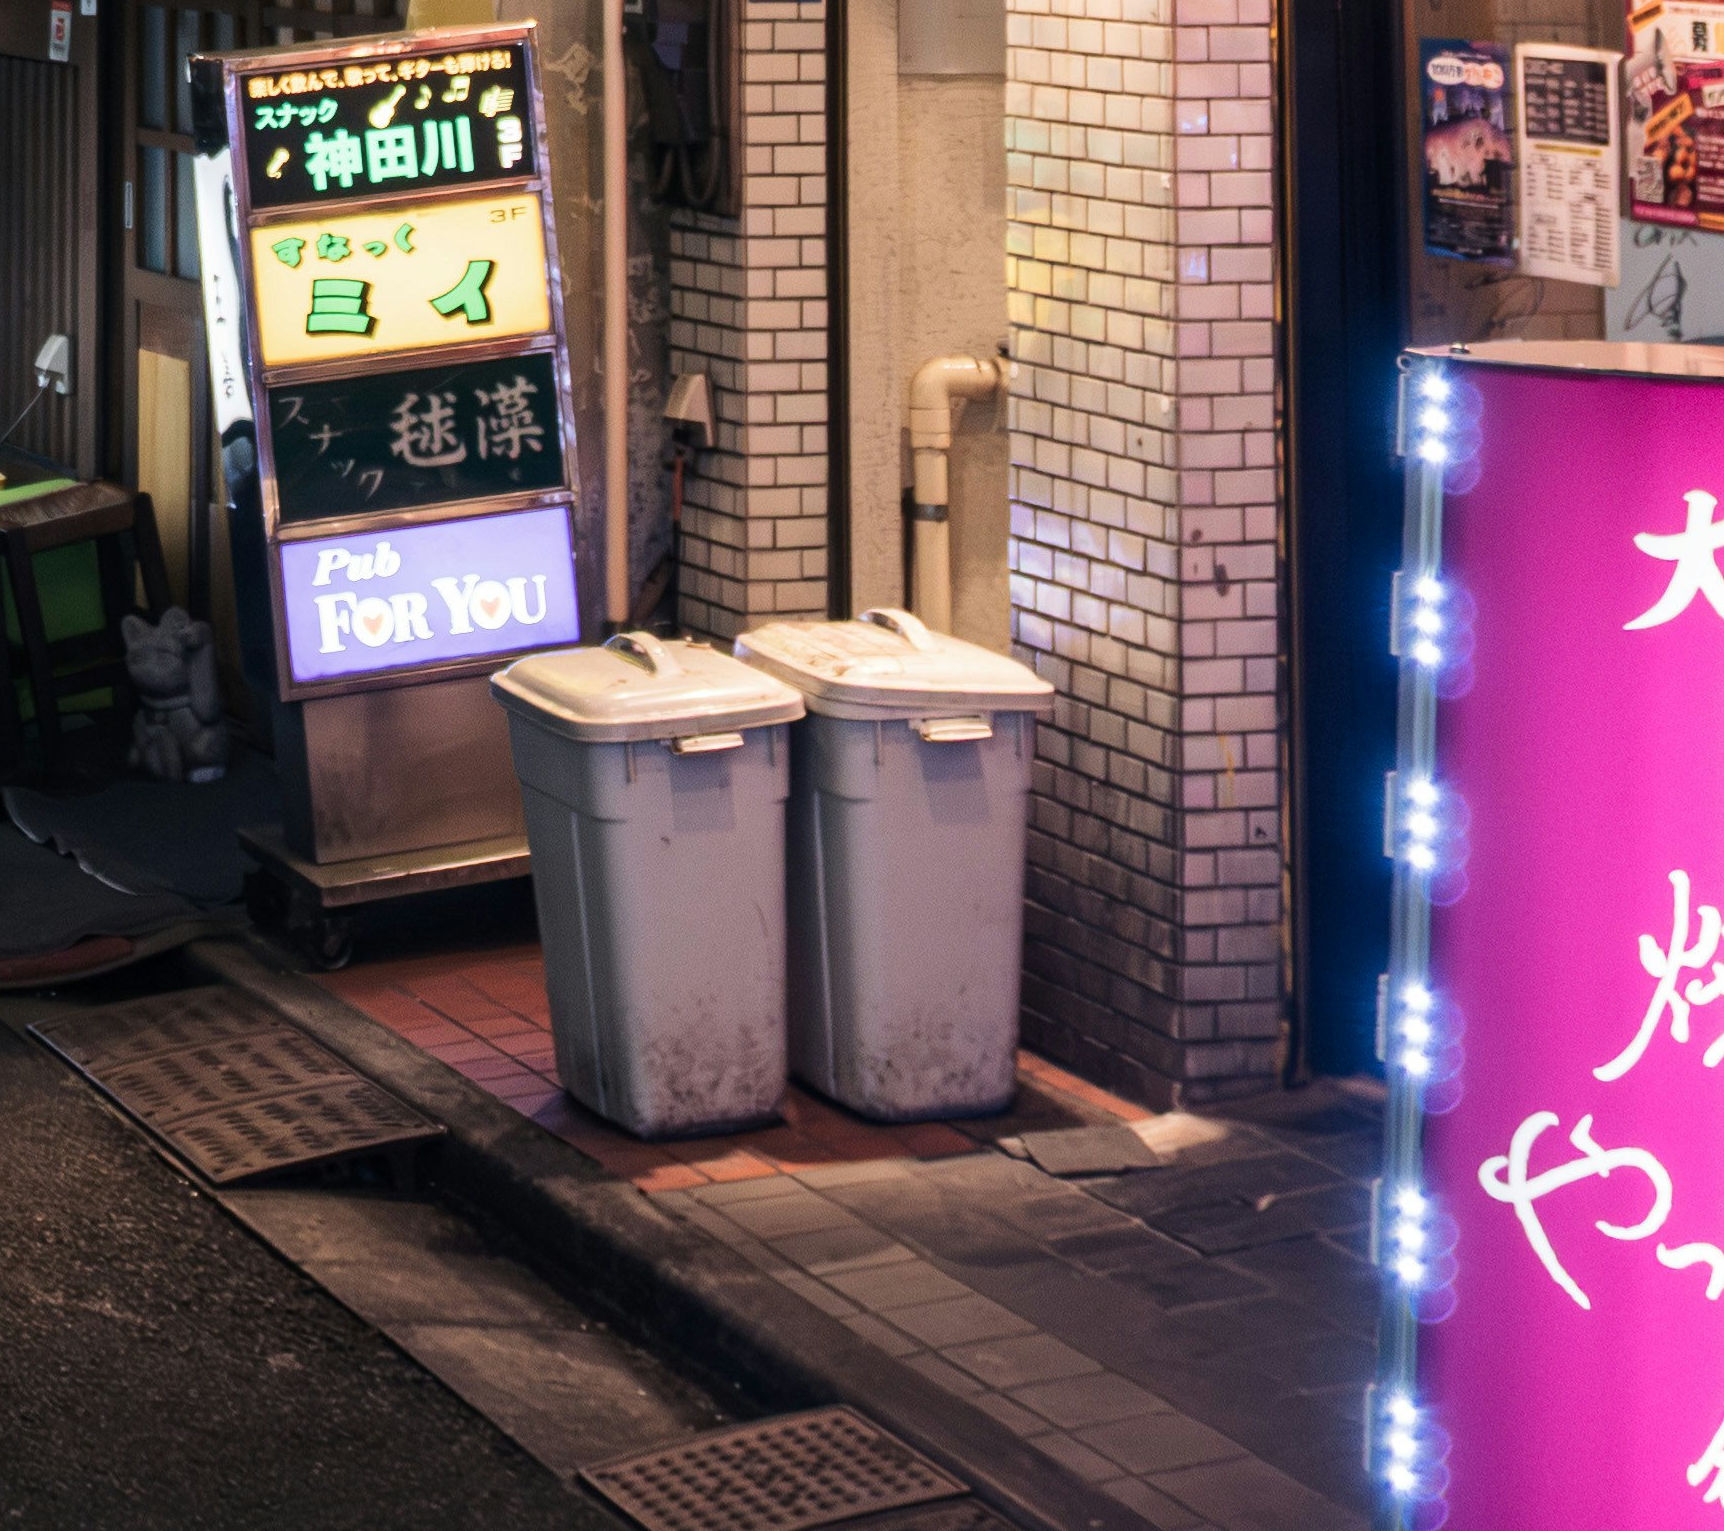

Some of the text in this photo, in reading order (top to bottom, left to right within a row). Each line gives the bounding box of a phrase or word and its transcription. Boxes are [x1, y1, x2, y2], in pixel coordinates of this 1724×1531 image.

[254, 97, 338, 131] スナック
[304, 114, 475, 191] 神田川
[496, 115, 523, 169] 3F
[489, 206, 528, 224] 3F
[270, 222, 417, 268] すなっく
[305, 259, 496, 338] ミイ
[311, 541, 402, 587] Pub
[313, 573, 548, 655] FOR YOU
